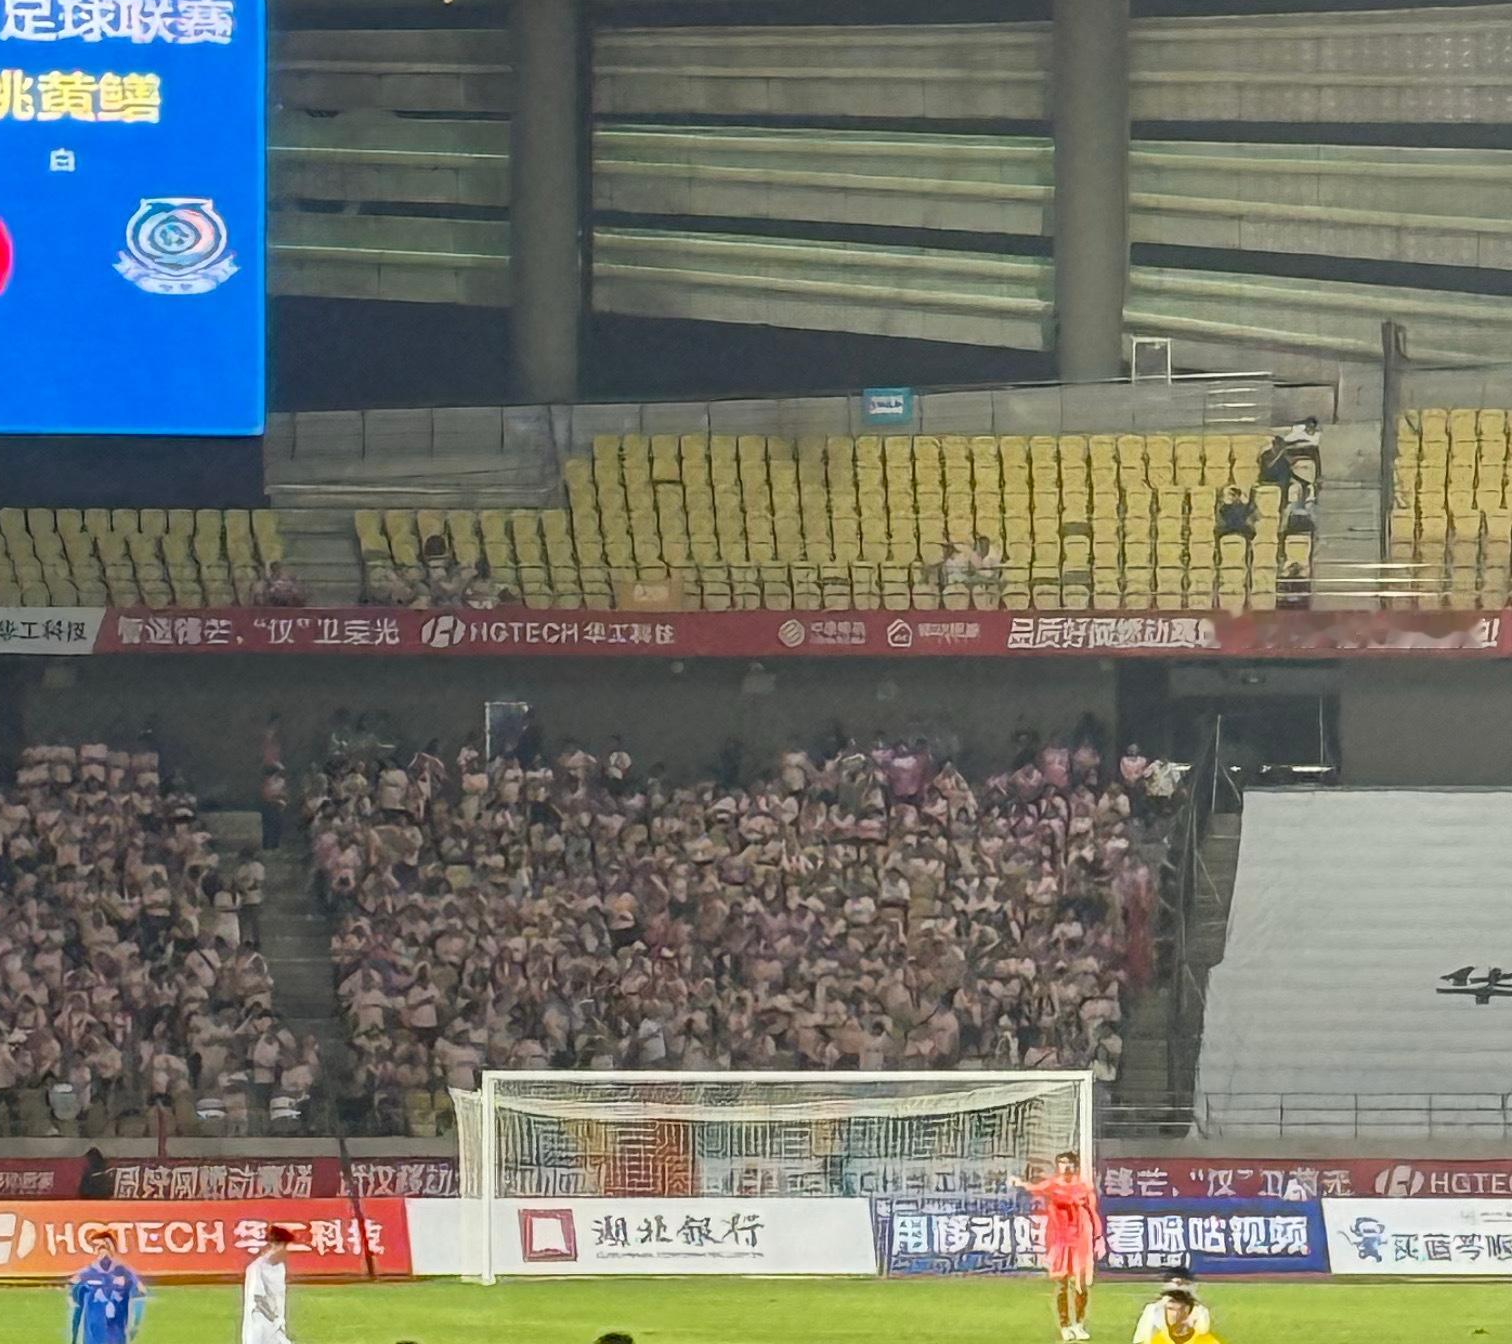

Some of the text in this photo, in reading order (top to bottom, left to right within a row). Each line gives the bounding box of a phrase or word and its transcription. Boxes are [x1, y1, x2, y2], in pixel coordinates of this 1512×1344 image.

[1431, 1172, 1512, 1197] HGTE
[594, 1213, 765, 1248] 湖北银行
